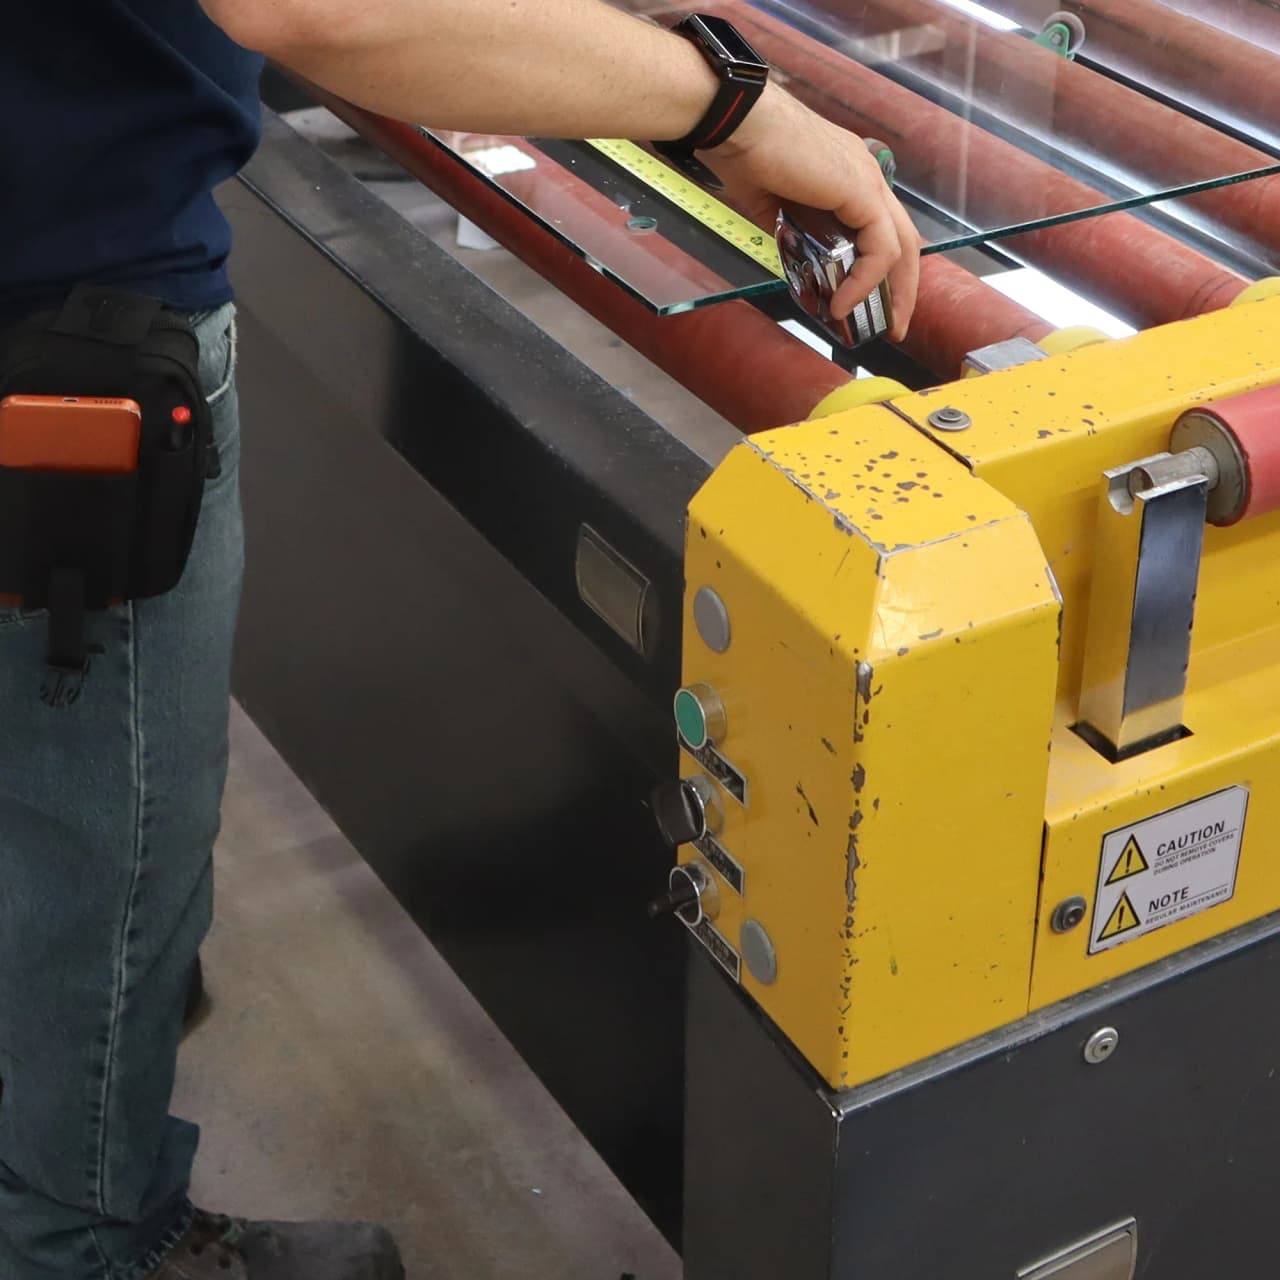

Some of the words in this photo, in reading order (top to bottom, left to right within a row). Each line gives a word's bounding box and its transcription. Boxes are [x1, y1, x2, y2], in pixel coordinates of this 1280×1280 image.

[1154, 860, 1165, 869] DO
[1165, 855, 1179, 864] NOT
[1180, 843, 1208, 858] REMOVE
[1208, 833, 1234, 847] COVERS
[1157, 820, 1225, 857] CAUTION
[1153, 861, 1179, 876] DURING
[1179, 846, 1217, 866] OPERATION
[1145, 907, 1178, 925] REGULAR
[1180, 887, 1228, 911] MAINTENANCE
[1148, 886, 1190, 913] NOTE
